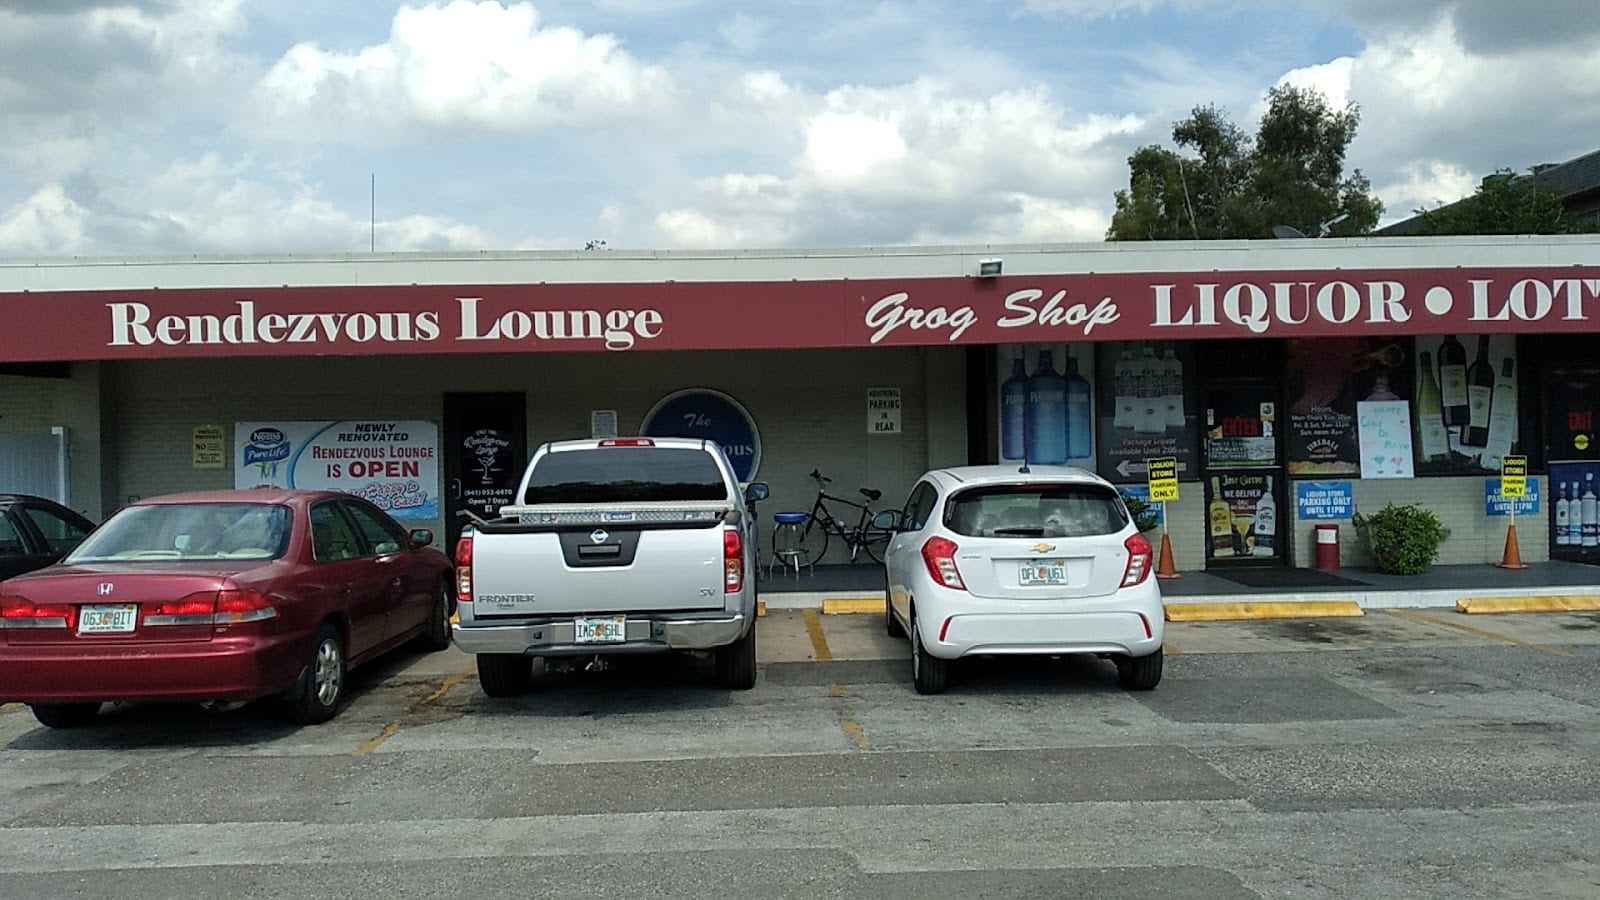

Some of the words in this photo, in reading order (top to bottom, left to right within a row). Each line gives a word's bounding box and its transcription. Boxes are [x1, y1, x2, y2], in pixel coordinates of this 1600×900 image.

[1149, 281, 1412, 333] LIQUOR
[865, 292, 978, 344] Grog
[996, 289, 1121, 335] Shop
[105, 300, 441, 346] Rendezvous
[455, 297, 664, 351] Lounge
[869, 399, 900, 409] PARKING
[683, 413, 711, 427] The
[355, 424, 396, 432] NEWLY
[875, 422, 894, 431] REAR
[338, 433, 409, 442] RENOVATED
[312, 446, 385, 459] RENDEZVOUS
[390, 445, 434, 458] LOUNGE
[327, 464, 341, 478] IS
[348, 461, 419, 478] OPEN
[1149, 461, 1175, 469] LIQUOR
[1151, 470, 1174, 478] STORE
[1153, 489, 1175, 498] ONLY
[1223, 490, 1235, 498] WE
[1235, 489, 1261, 498] DELIVER
[1306, 490, 1326, 498] LIQUOR
[1299, 498, 1331, 506] PARKING
[1333, 497, 1351, 506] ONLY
[1306, 506, 1325, 515] UNTIL
[1327, 506, 1346, 514] 11PM
[700, 588, 716, 597] SV
